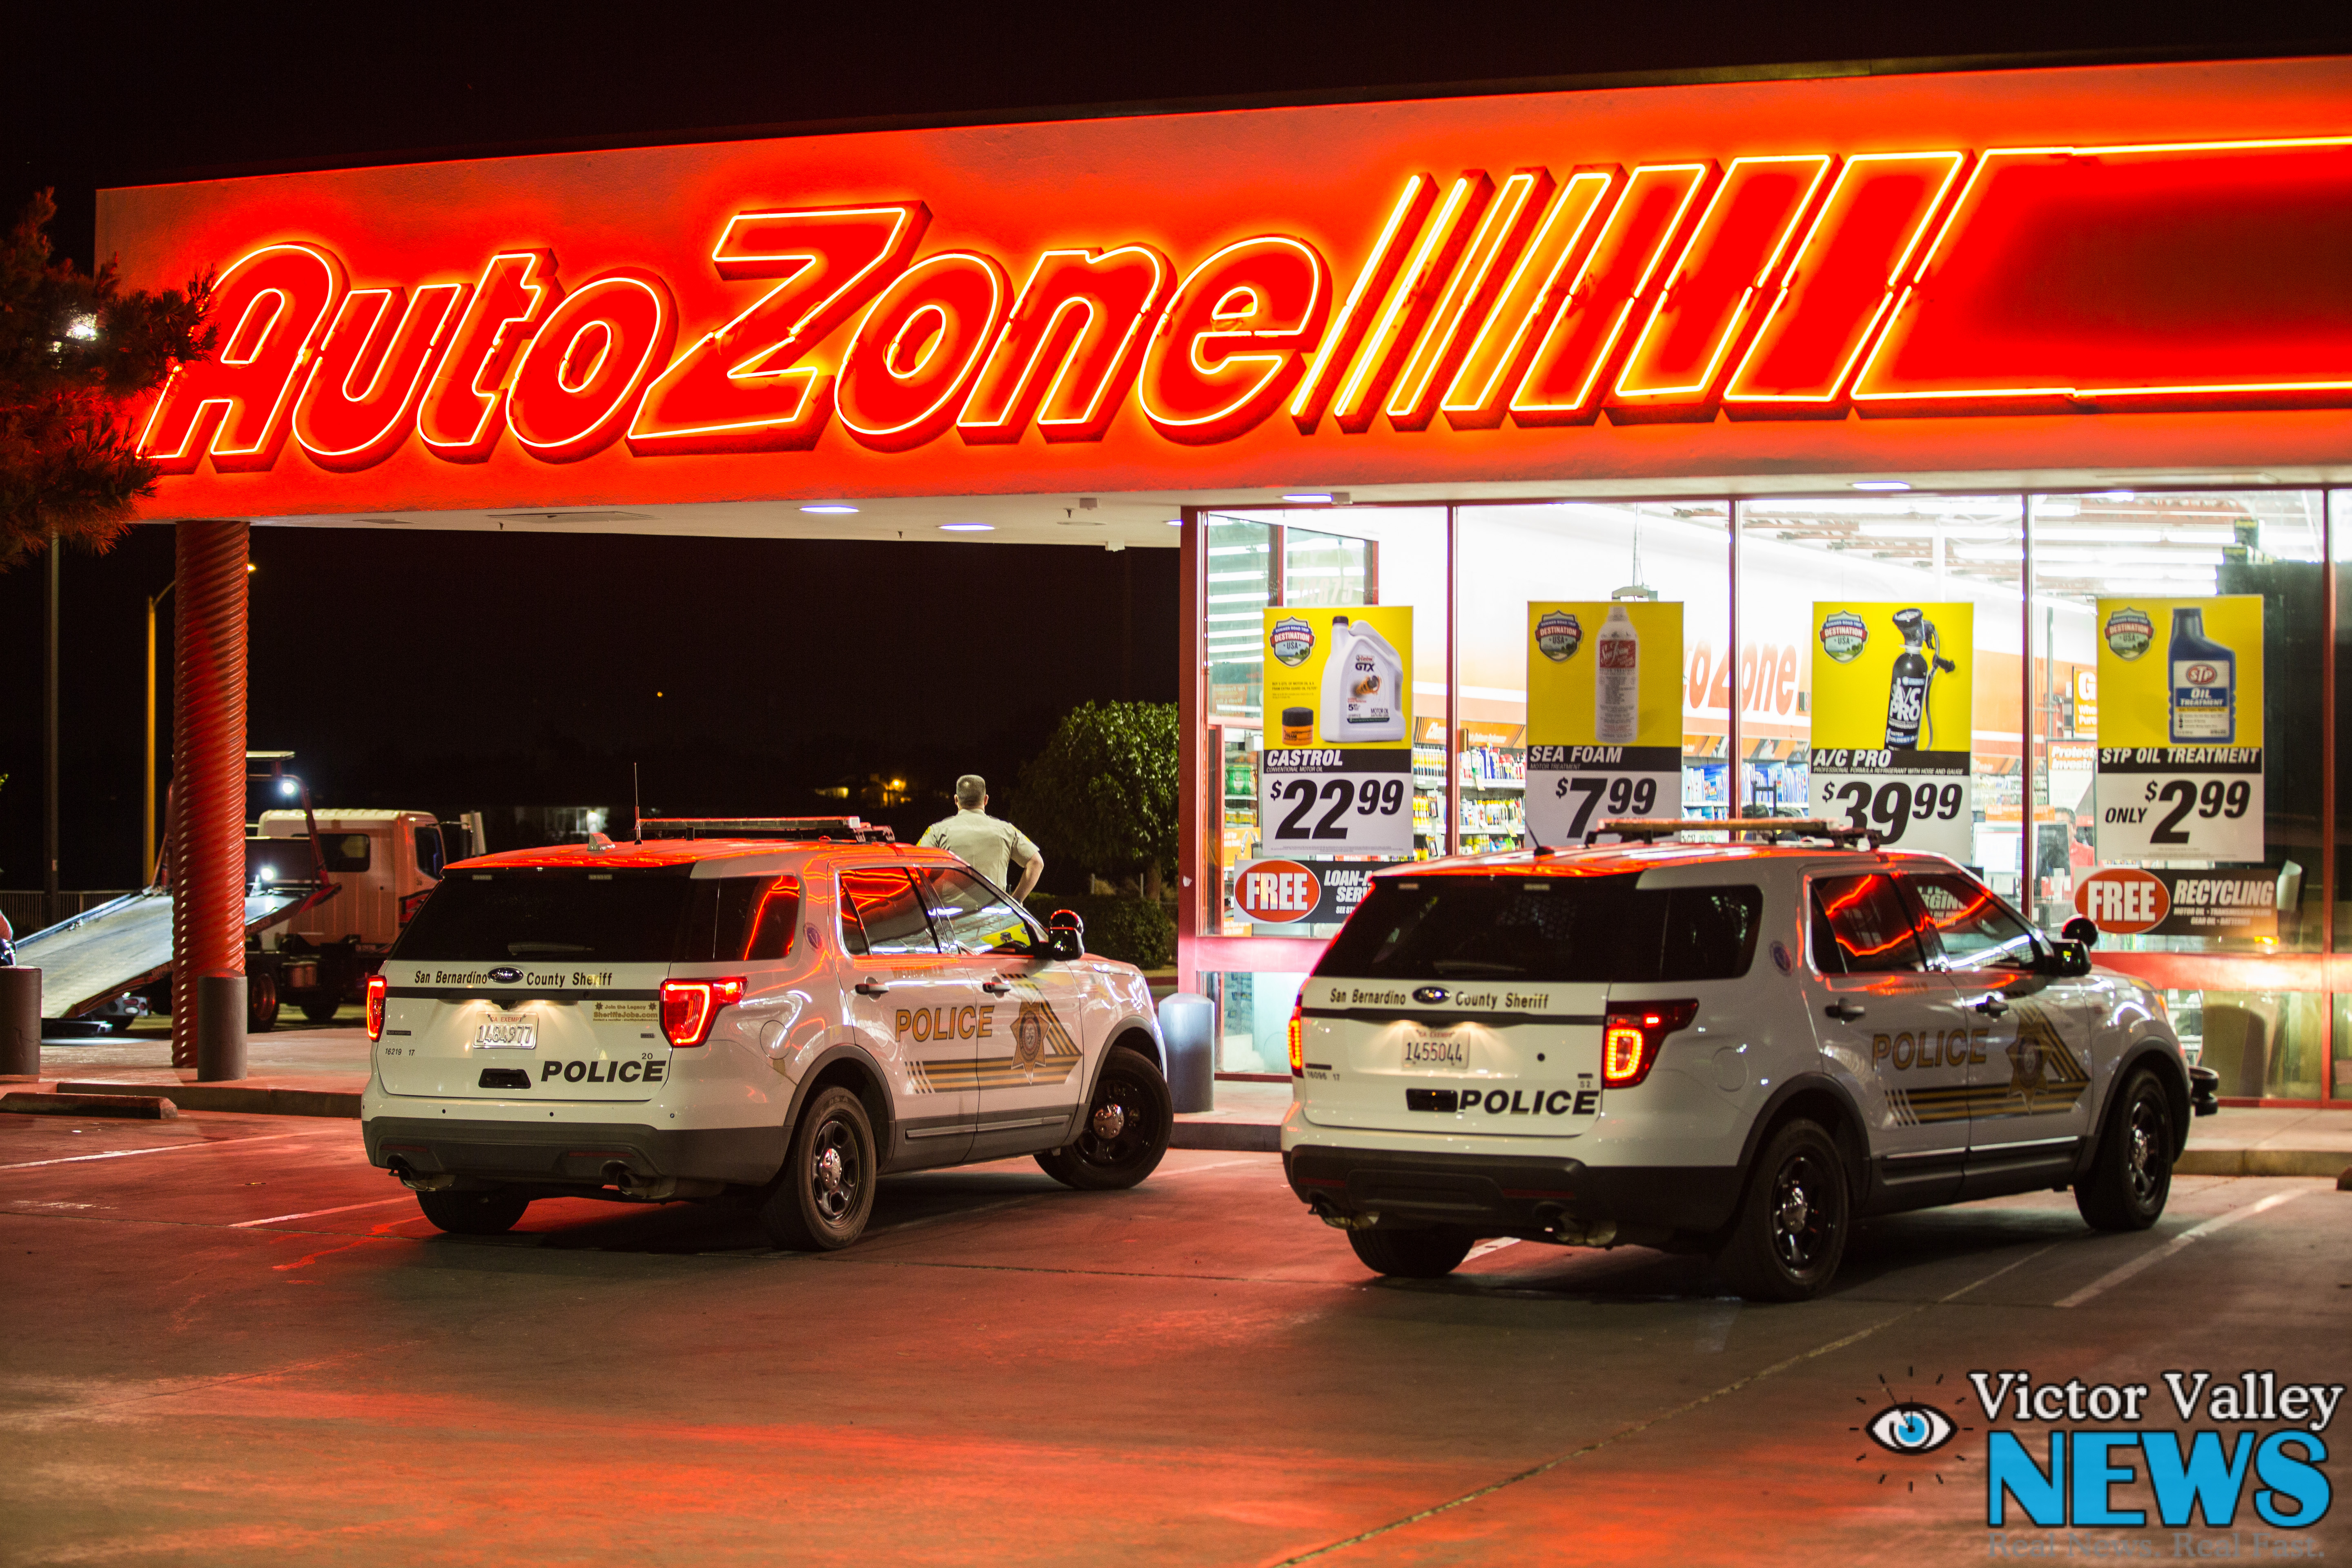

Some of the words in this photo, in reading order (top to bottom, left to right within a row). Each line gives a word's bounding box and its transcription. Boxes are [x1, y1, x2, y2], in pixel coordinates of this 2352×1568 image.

[136, 201, 1332, 474] AutoZone
[1274, 632, 1310, 643] DESTINATION
[1540, 626, 1576, 637] DESTINATION
[1825, 626, 1862, 637] DESTINATION
[2109, 623, 2148, 635] DESTINATION
[1355, 663, 1374, 672] GTX
[2190, 666, 2213, 682] STP
[2191, 688, 2212, 699] OIL
[1889, 700, 1921, 721] PRO
[1267, 750, 1343, 766] CASTROL
[1530, 746, 1564, 763] SEA
[1571, 746, 1623, 763] FOAM
[1813, 749, 1848, 767] A/C
[1852, 749, 1891, 768] PRO
[2101, 748, 2132, 764] STP
[2136, 748, 2161, 764] OIL
[2167, 748, 2259, 764] TREATMENT
[2105, 807, 2148, 824] ONLY
[1247, 872, 1308, 910] FREE
[2173, 879, 2274, 906] RECYCLING
[2088, 880, 2156, 922] FREE
[414, 971, 430, 984] San
[436, 971, 488, 984] Bernardino
[527, 972, 565, 988] County
[572, 972, 612, 985] Sheriff
[1330, 987, 1346, 1002] San
[1352, 988, 1406, 1005] Bernardino
[1456, 991, 1497, 1010] County
[1505, 992, 1549, 1009] Sheriff
[895, 1005, 995, 1042] POLICE
[477, 1025, 532, 1043] 1484977
[1405, 1042, 1462, 1062] 1455044
[1872, 1027, 1989, 1071] POLICE
[541, 1060, 666, 1082] POLICE
[1458, 1089, 1599, 1115] POLICE
